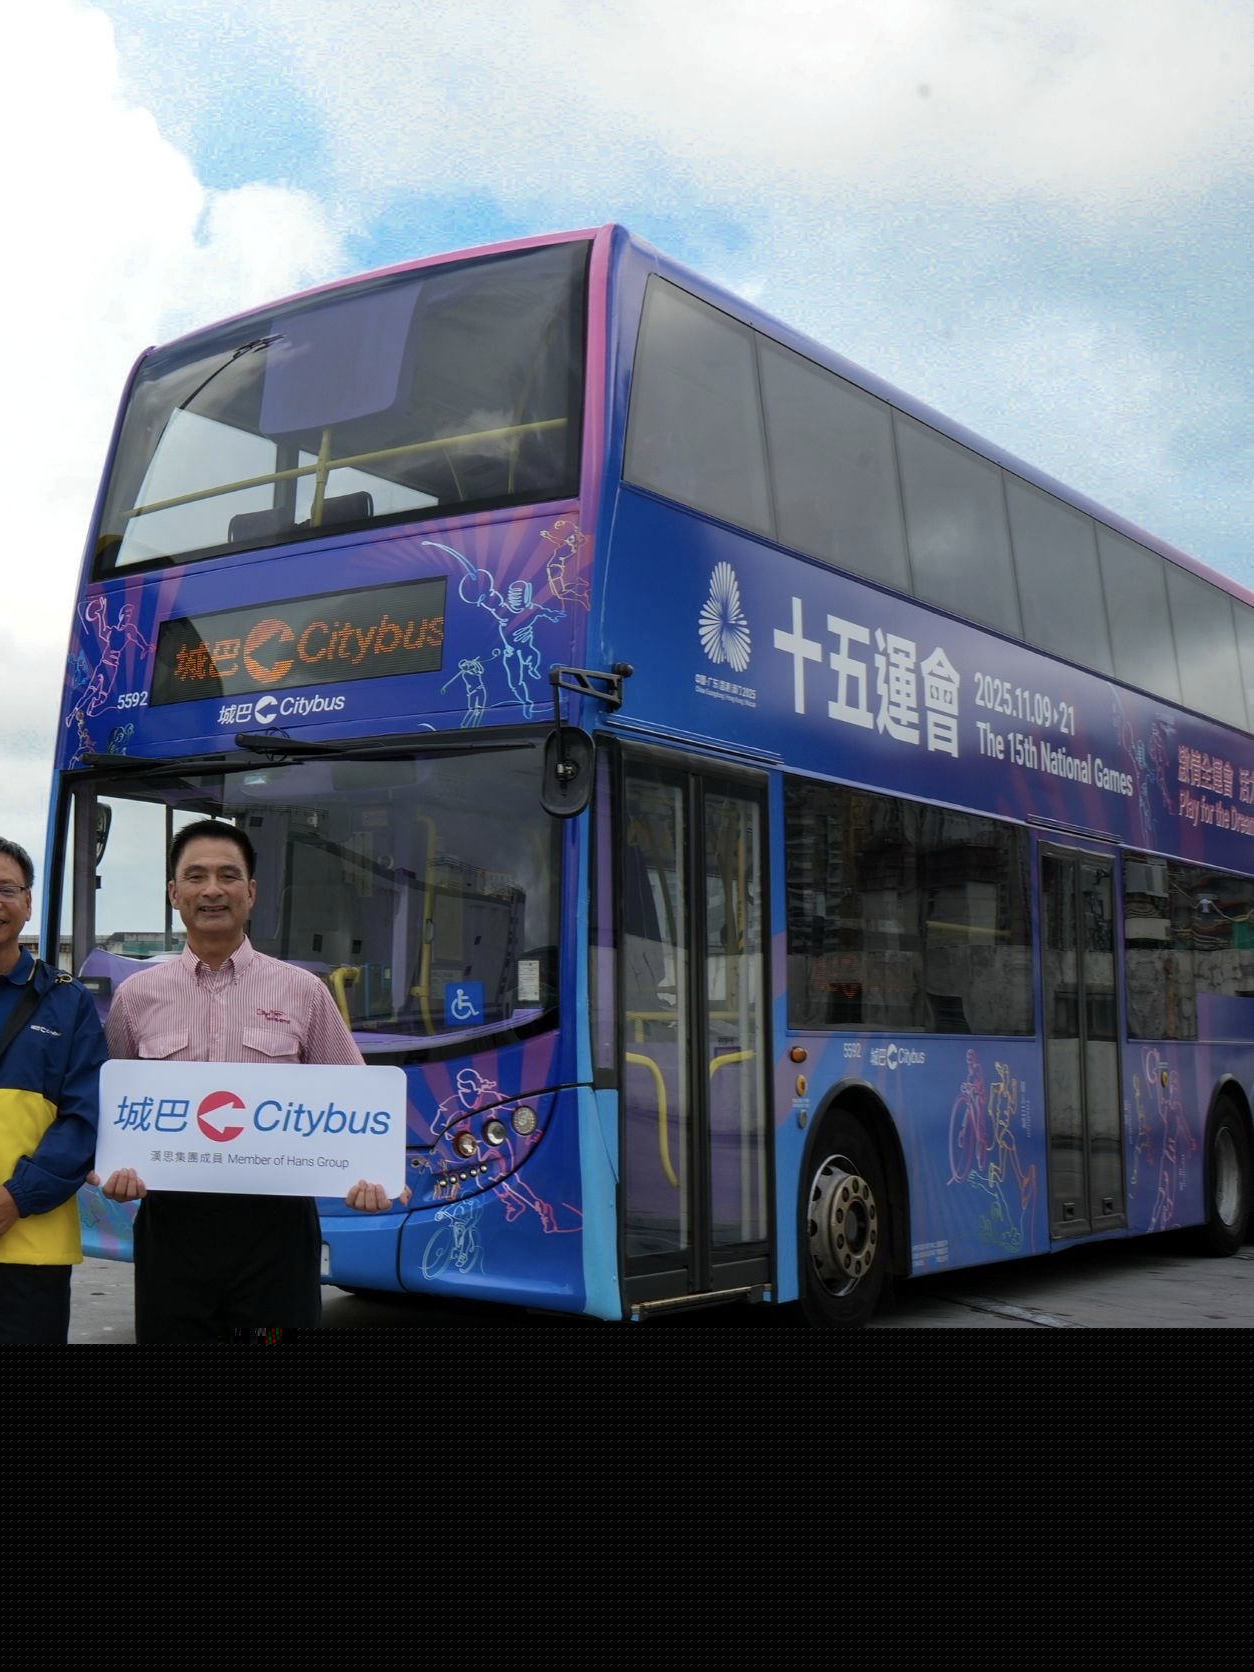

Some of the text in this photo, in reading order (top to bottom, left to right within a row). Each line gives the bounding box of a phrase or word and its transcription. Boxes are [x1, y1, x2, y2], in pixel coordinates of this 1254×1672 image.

[174, 614, 444, 681] 城巴 Citybus
[773, 596, 960, 758] 十五運會
[117, 691, 148, 709] 5592
[217, 694, 345, 725] 城巴 Citybus
[976, 721, 1134, 798] The 15th National Games
[1178, 789, 1200, 827] Play
[1201, 794, 1215, 824] for
[1215, 800, 1230, 829] the
[898, 1047, 926, 1066] Citybus
[113, 1096, 391, 1137] 城巴 Citybus
[150, 1150, 350, 1169] 漢思集團成員 Member of Hans Group
